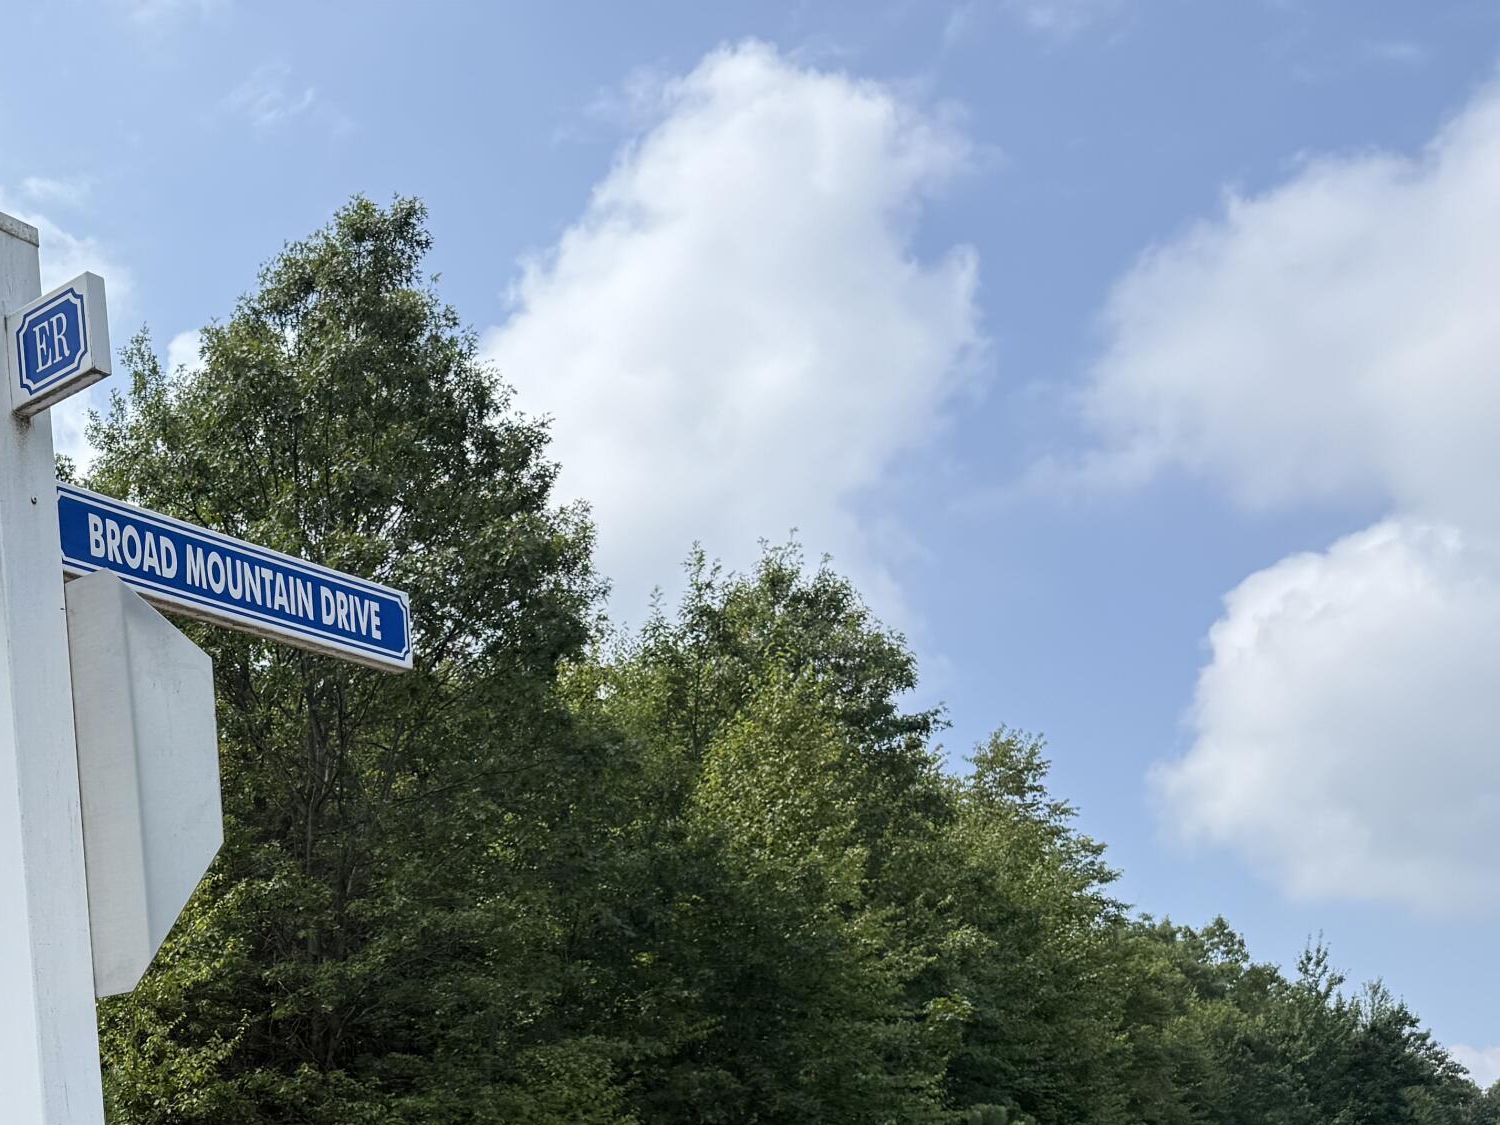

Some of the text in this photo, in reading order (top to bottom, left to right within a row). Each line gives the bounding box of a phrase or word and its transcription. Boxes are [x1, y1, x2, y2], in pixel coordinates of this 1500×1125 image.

[32, 312, 70, 374] ER
[88, 512, 382, 640] BROAD MOUNTAIN DRIVE
